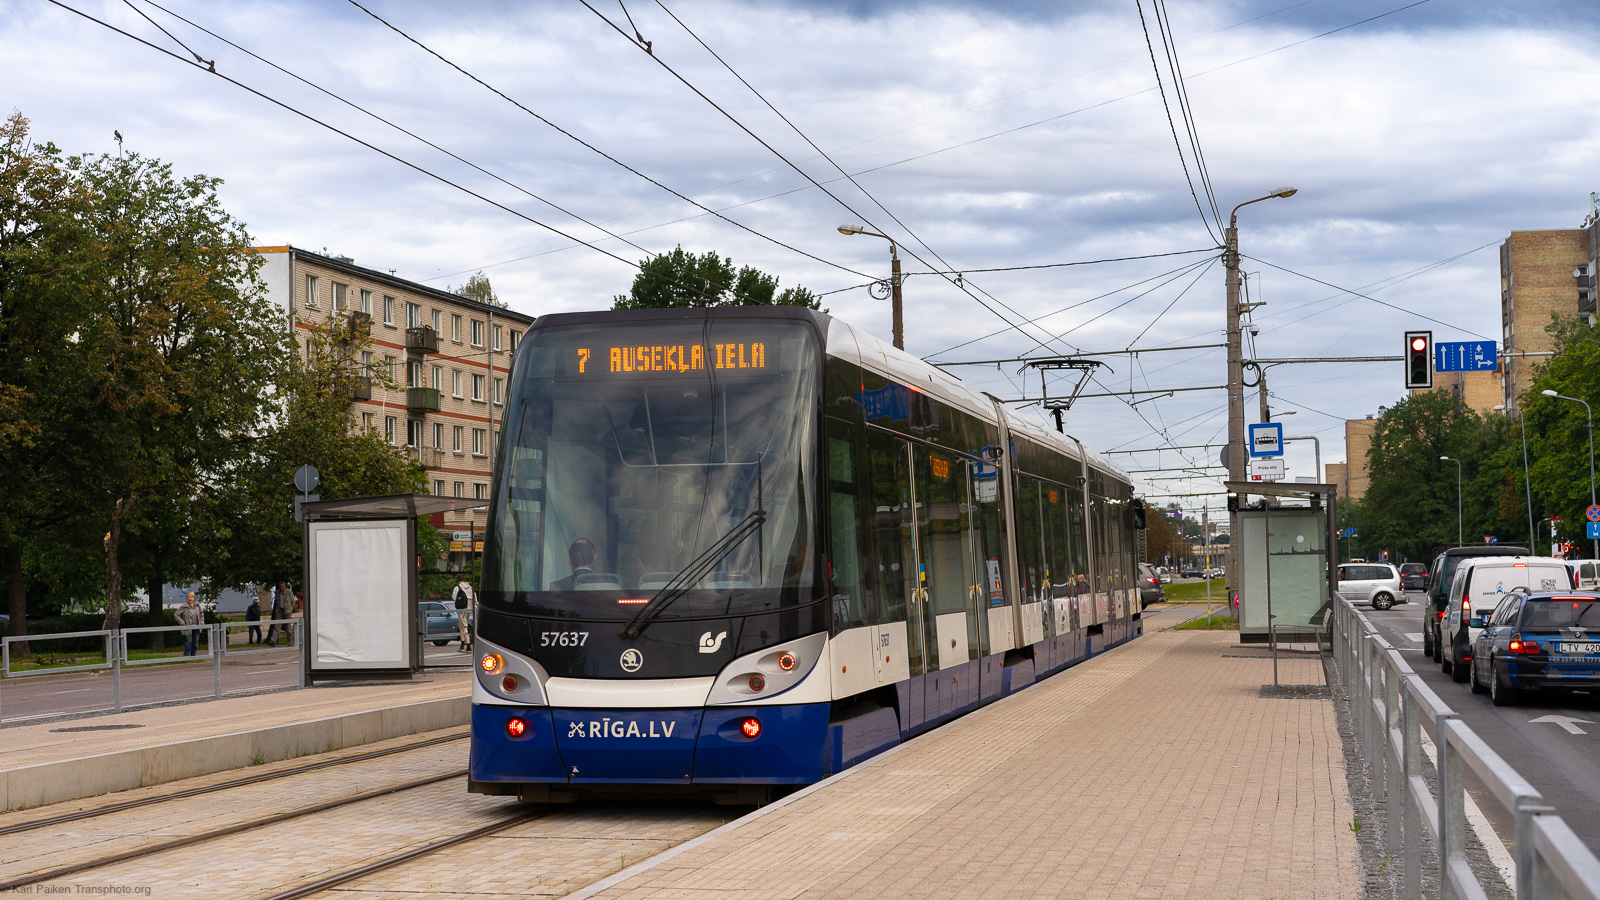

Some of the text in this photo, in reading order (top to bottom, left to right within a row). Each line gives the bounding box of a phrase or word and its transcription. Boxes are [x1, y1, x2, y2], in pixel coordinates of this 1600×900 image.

[577, 342, 766, 373] 7 AUSEKĻA IELA
[540, 631, 590, 648] 57637
[1560, 644, 1580, 652] LTV
[589, 717, 676, 738] RĪGA.LV
